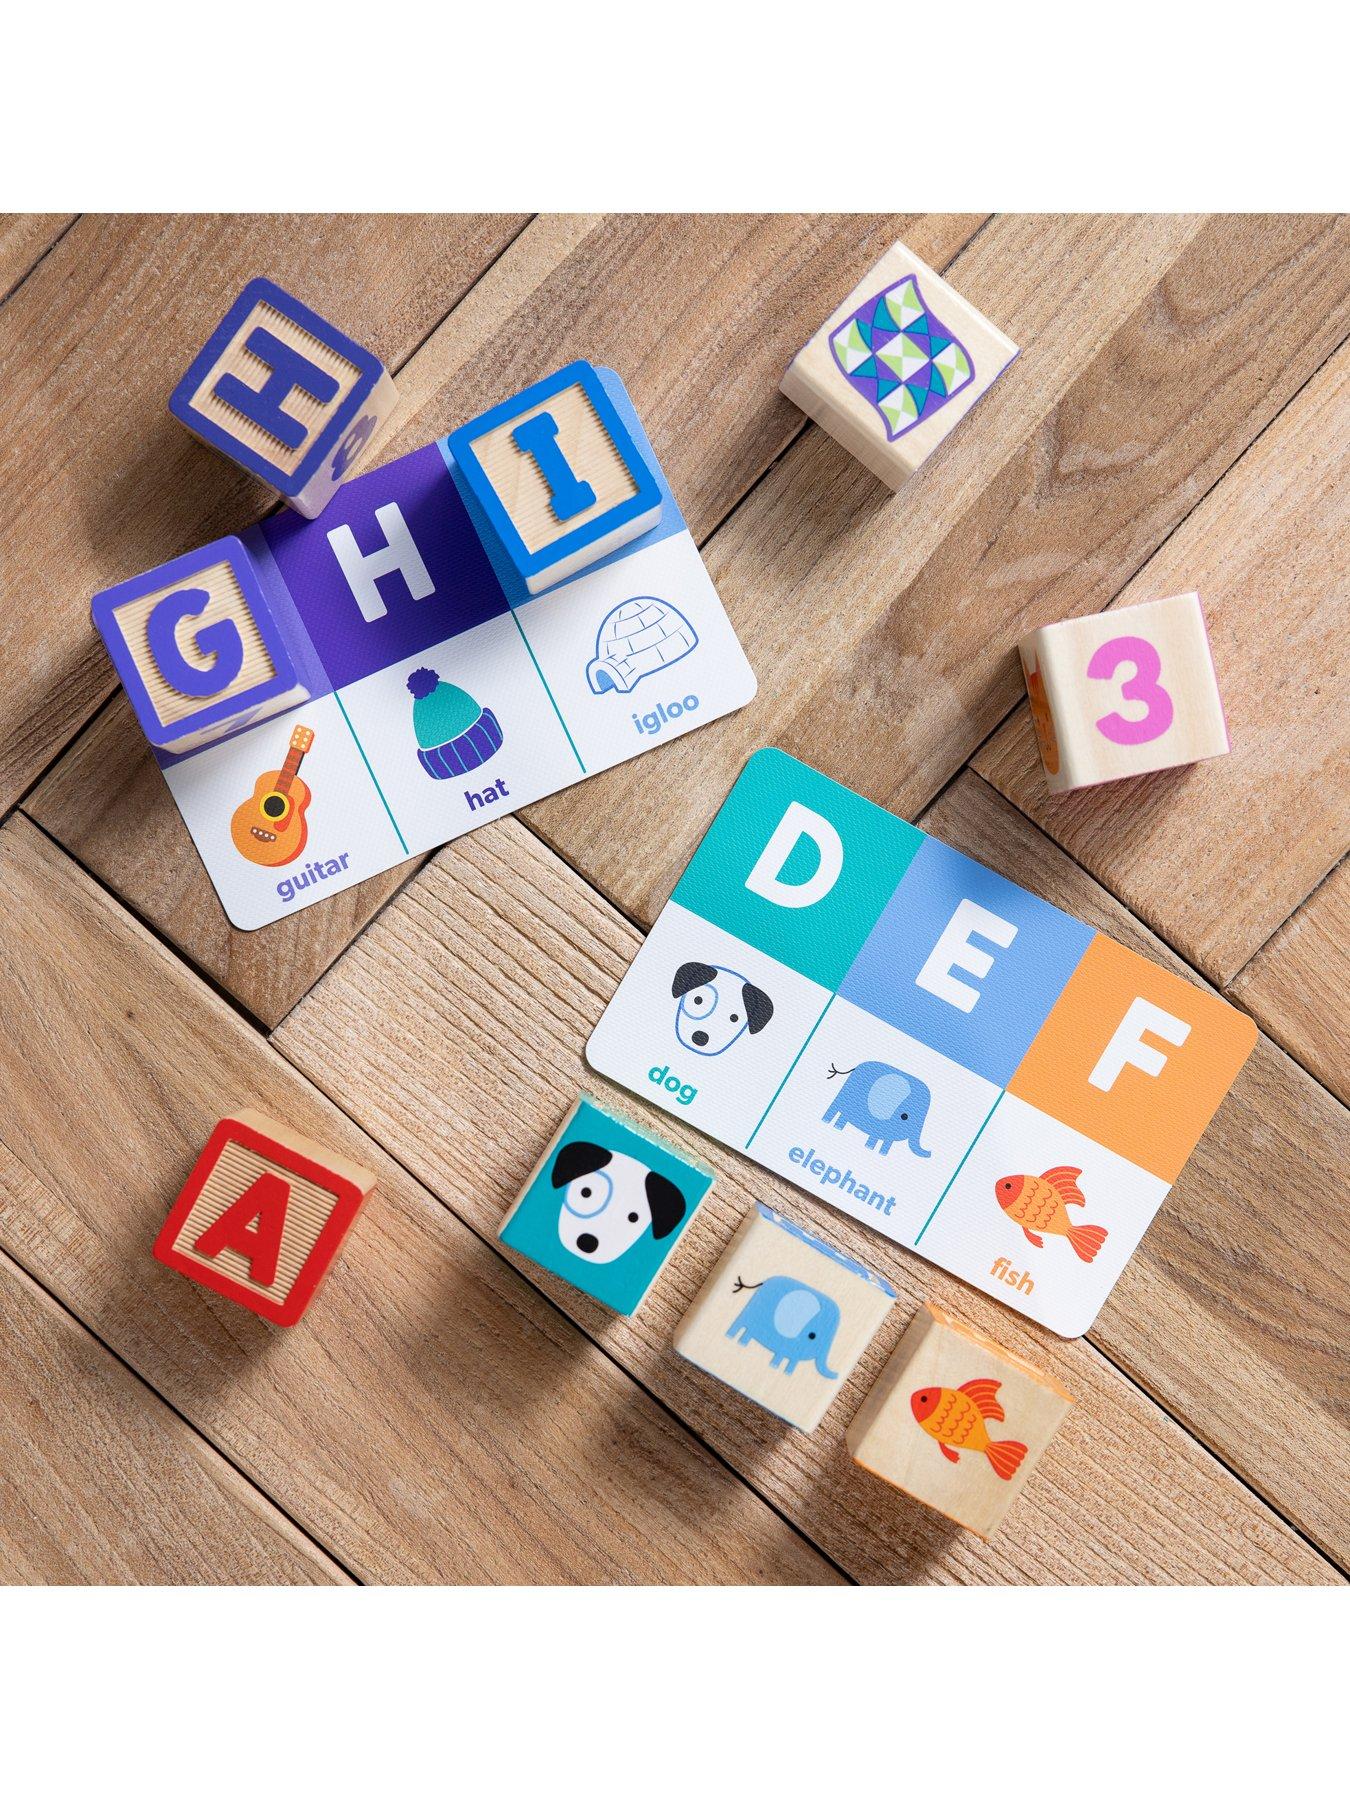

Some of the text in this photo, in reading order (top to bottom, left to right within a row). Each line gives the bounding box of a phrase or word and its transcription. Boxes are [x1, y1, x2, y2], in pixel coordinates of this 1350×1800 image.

[215, 328, 339, 448] H
[512, 412, 596, 520] I
[327, 502, 435, 622] H
[147, 589, 244, 697] G
[1088, 637, 1173, 745] 3
[631, 694, 699, 735] igloo
[464, 778, 509, 811] hat
[276, 852, 349, 902] guitar
[745, 802, 843, 908] D
[915, 899, 1018, 1013] E
[648, 1066, 698, 1105] dog
[1088, 997, 1191, 1092] F
[194, 1172, 290, 1287] A
[788, 1145, 896, 1216] elephant
[989, 1257, 1035, 1295] fish
